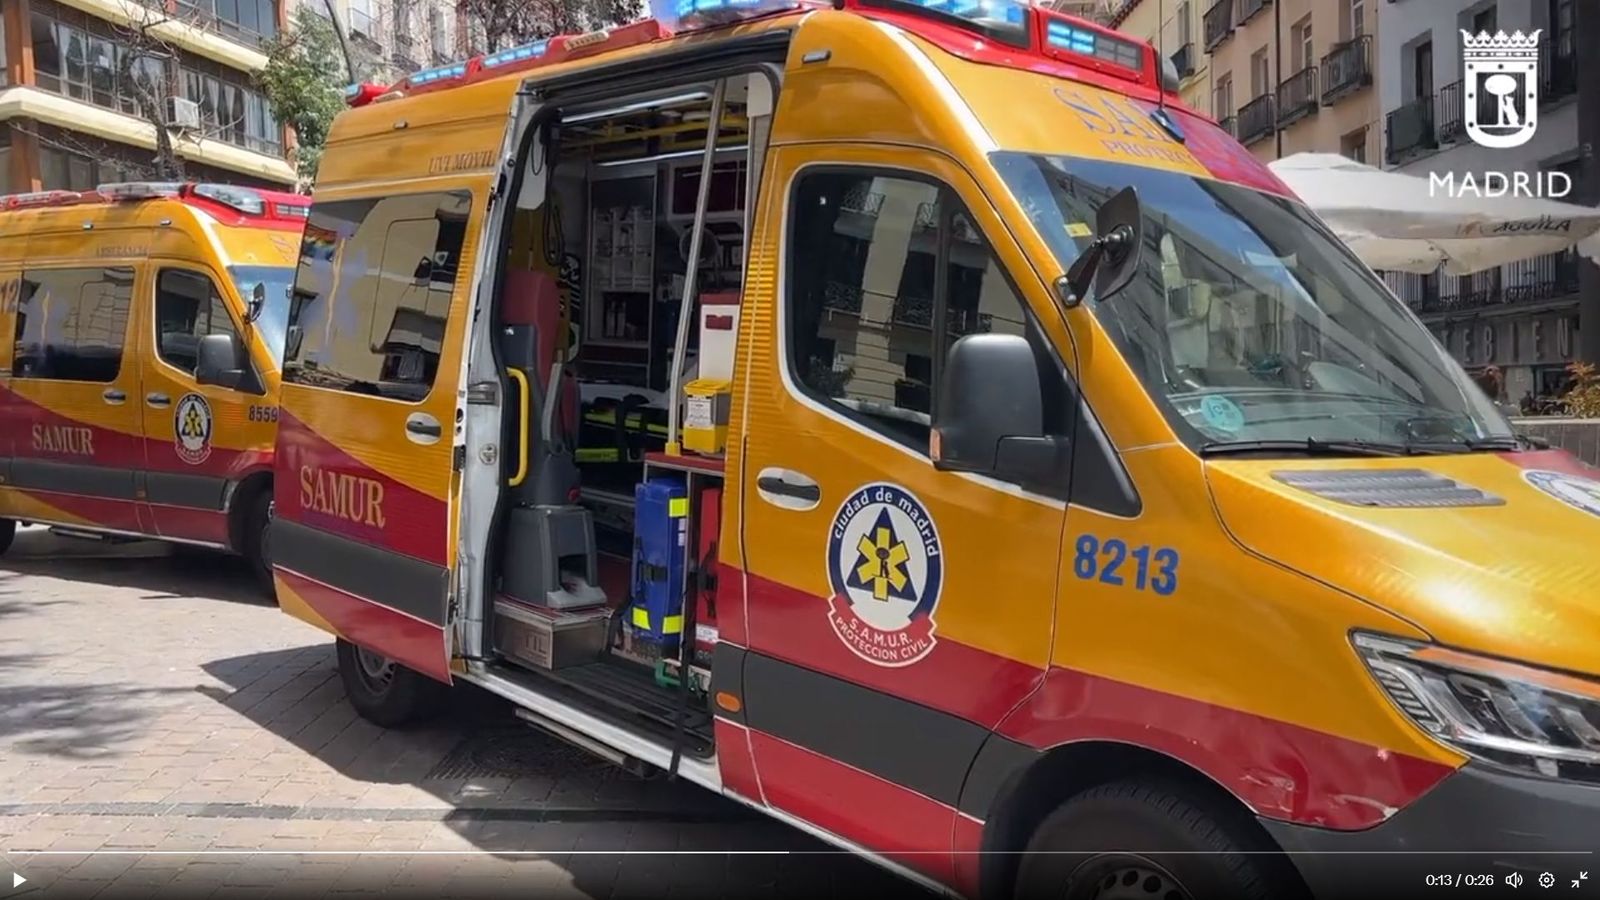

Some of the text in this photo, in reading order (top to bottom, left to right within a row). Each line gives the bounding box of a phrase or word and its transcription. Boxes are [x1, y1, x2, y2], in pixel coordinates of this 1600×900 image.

[249, 404, 278, 423] 8559
[32, 424, 95, 454] SAMUR
[300, 465, 386, 529] SAMUR
[834, 487, 939, 557] ciudad de madrid
[1074, 534, 1179, 596] 8213
[900, 638, 928, 659] CIVIL
